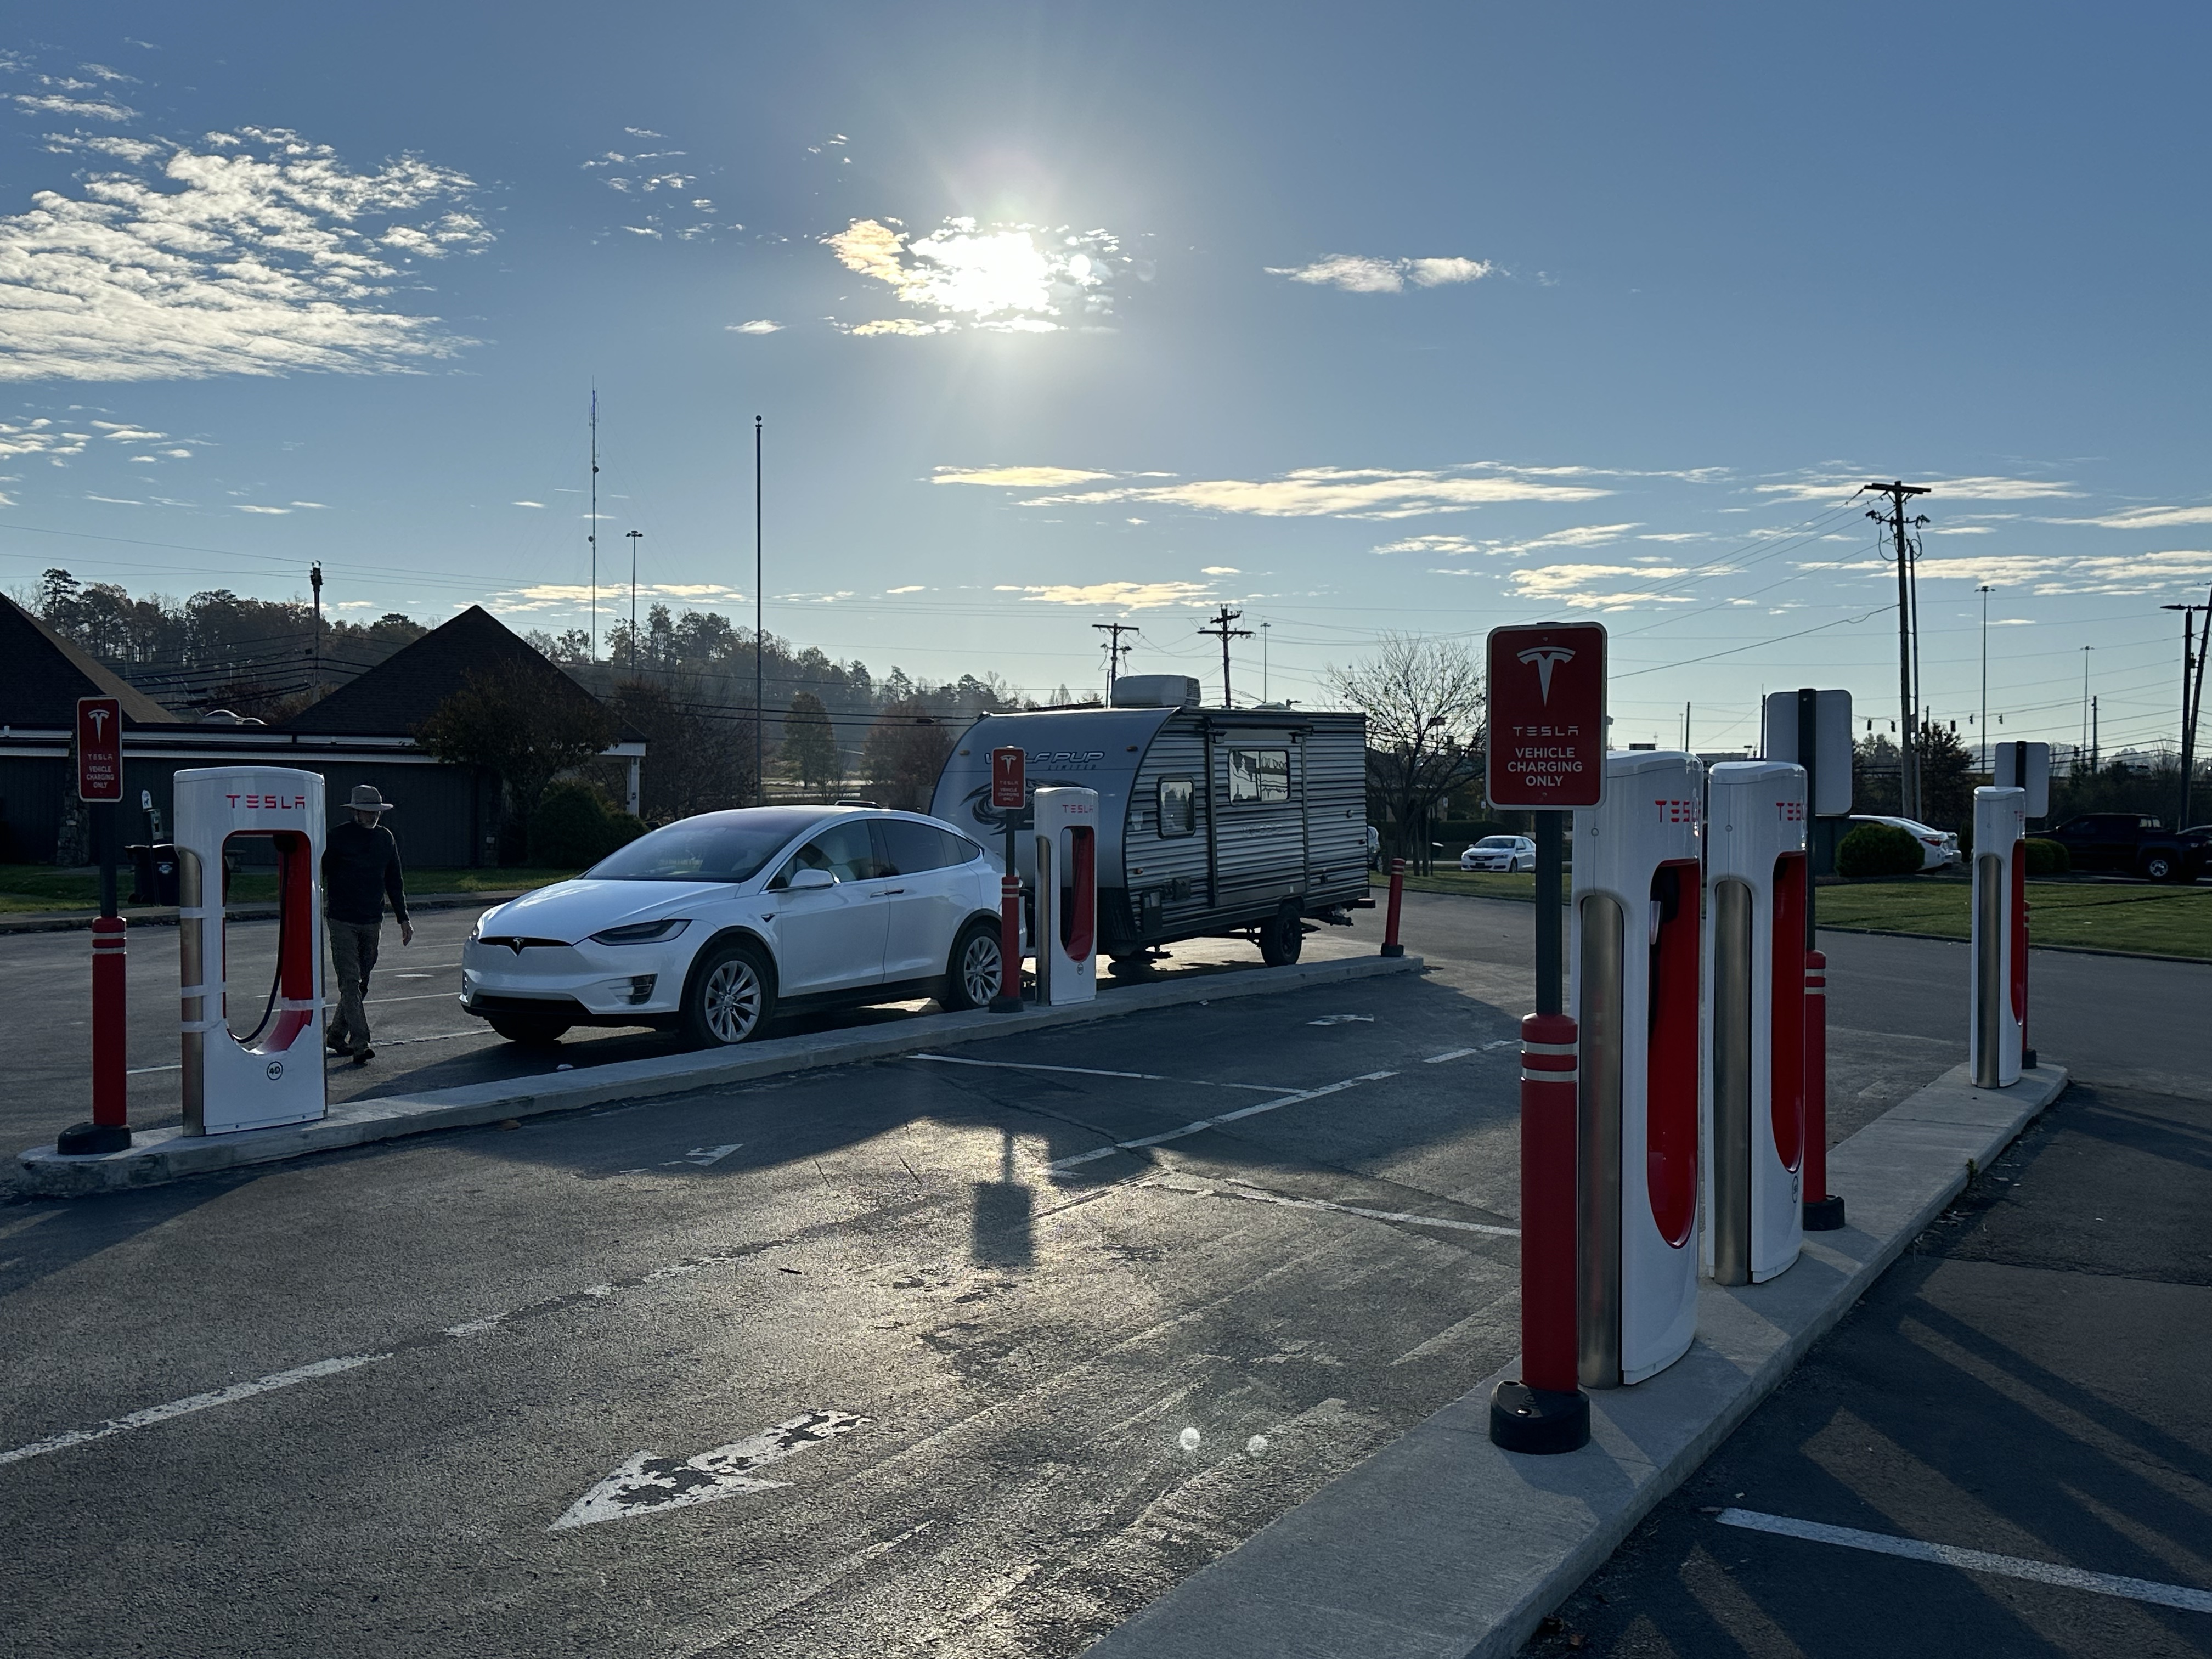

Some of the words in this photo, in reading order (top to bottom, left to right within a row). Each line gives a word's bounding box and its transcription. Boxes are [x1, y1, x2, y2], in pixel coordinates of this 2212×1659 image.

[1512, 725, 1579, 737] TESLA
[1051, 752, 1105, 764] PUP
[1515, 747, 1576, 759] VEHICLE
[1507, 761, 1583, 772] CHARGING
[1526, 775, 1564, 786] ONLY
[225, 795, 305, 809] TESLA
[1062, 804, 1093, 813] TESLA
